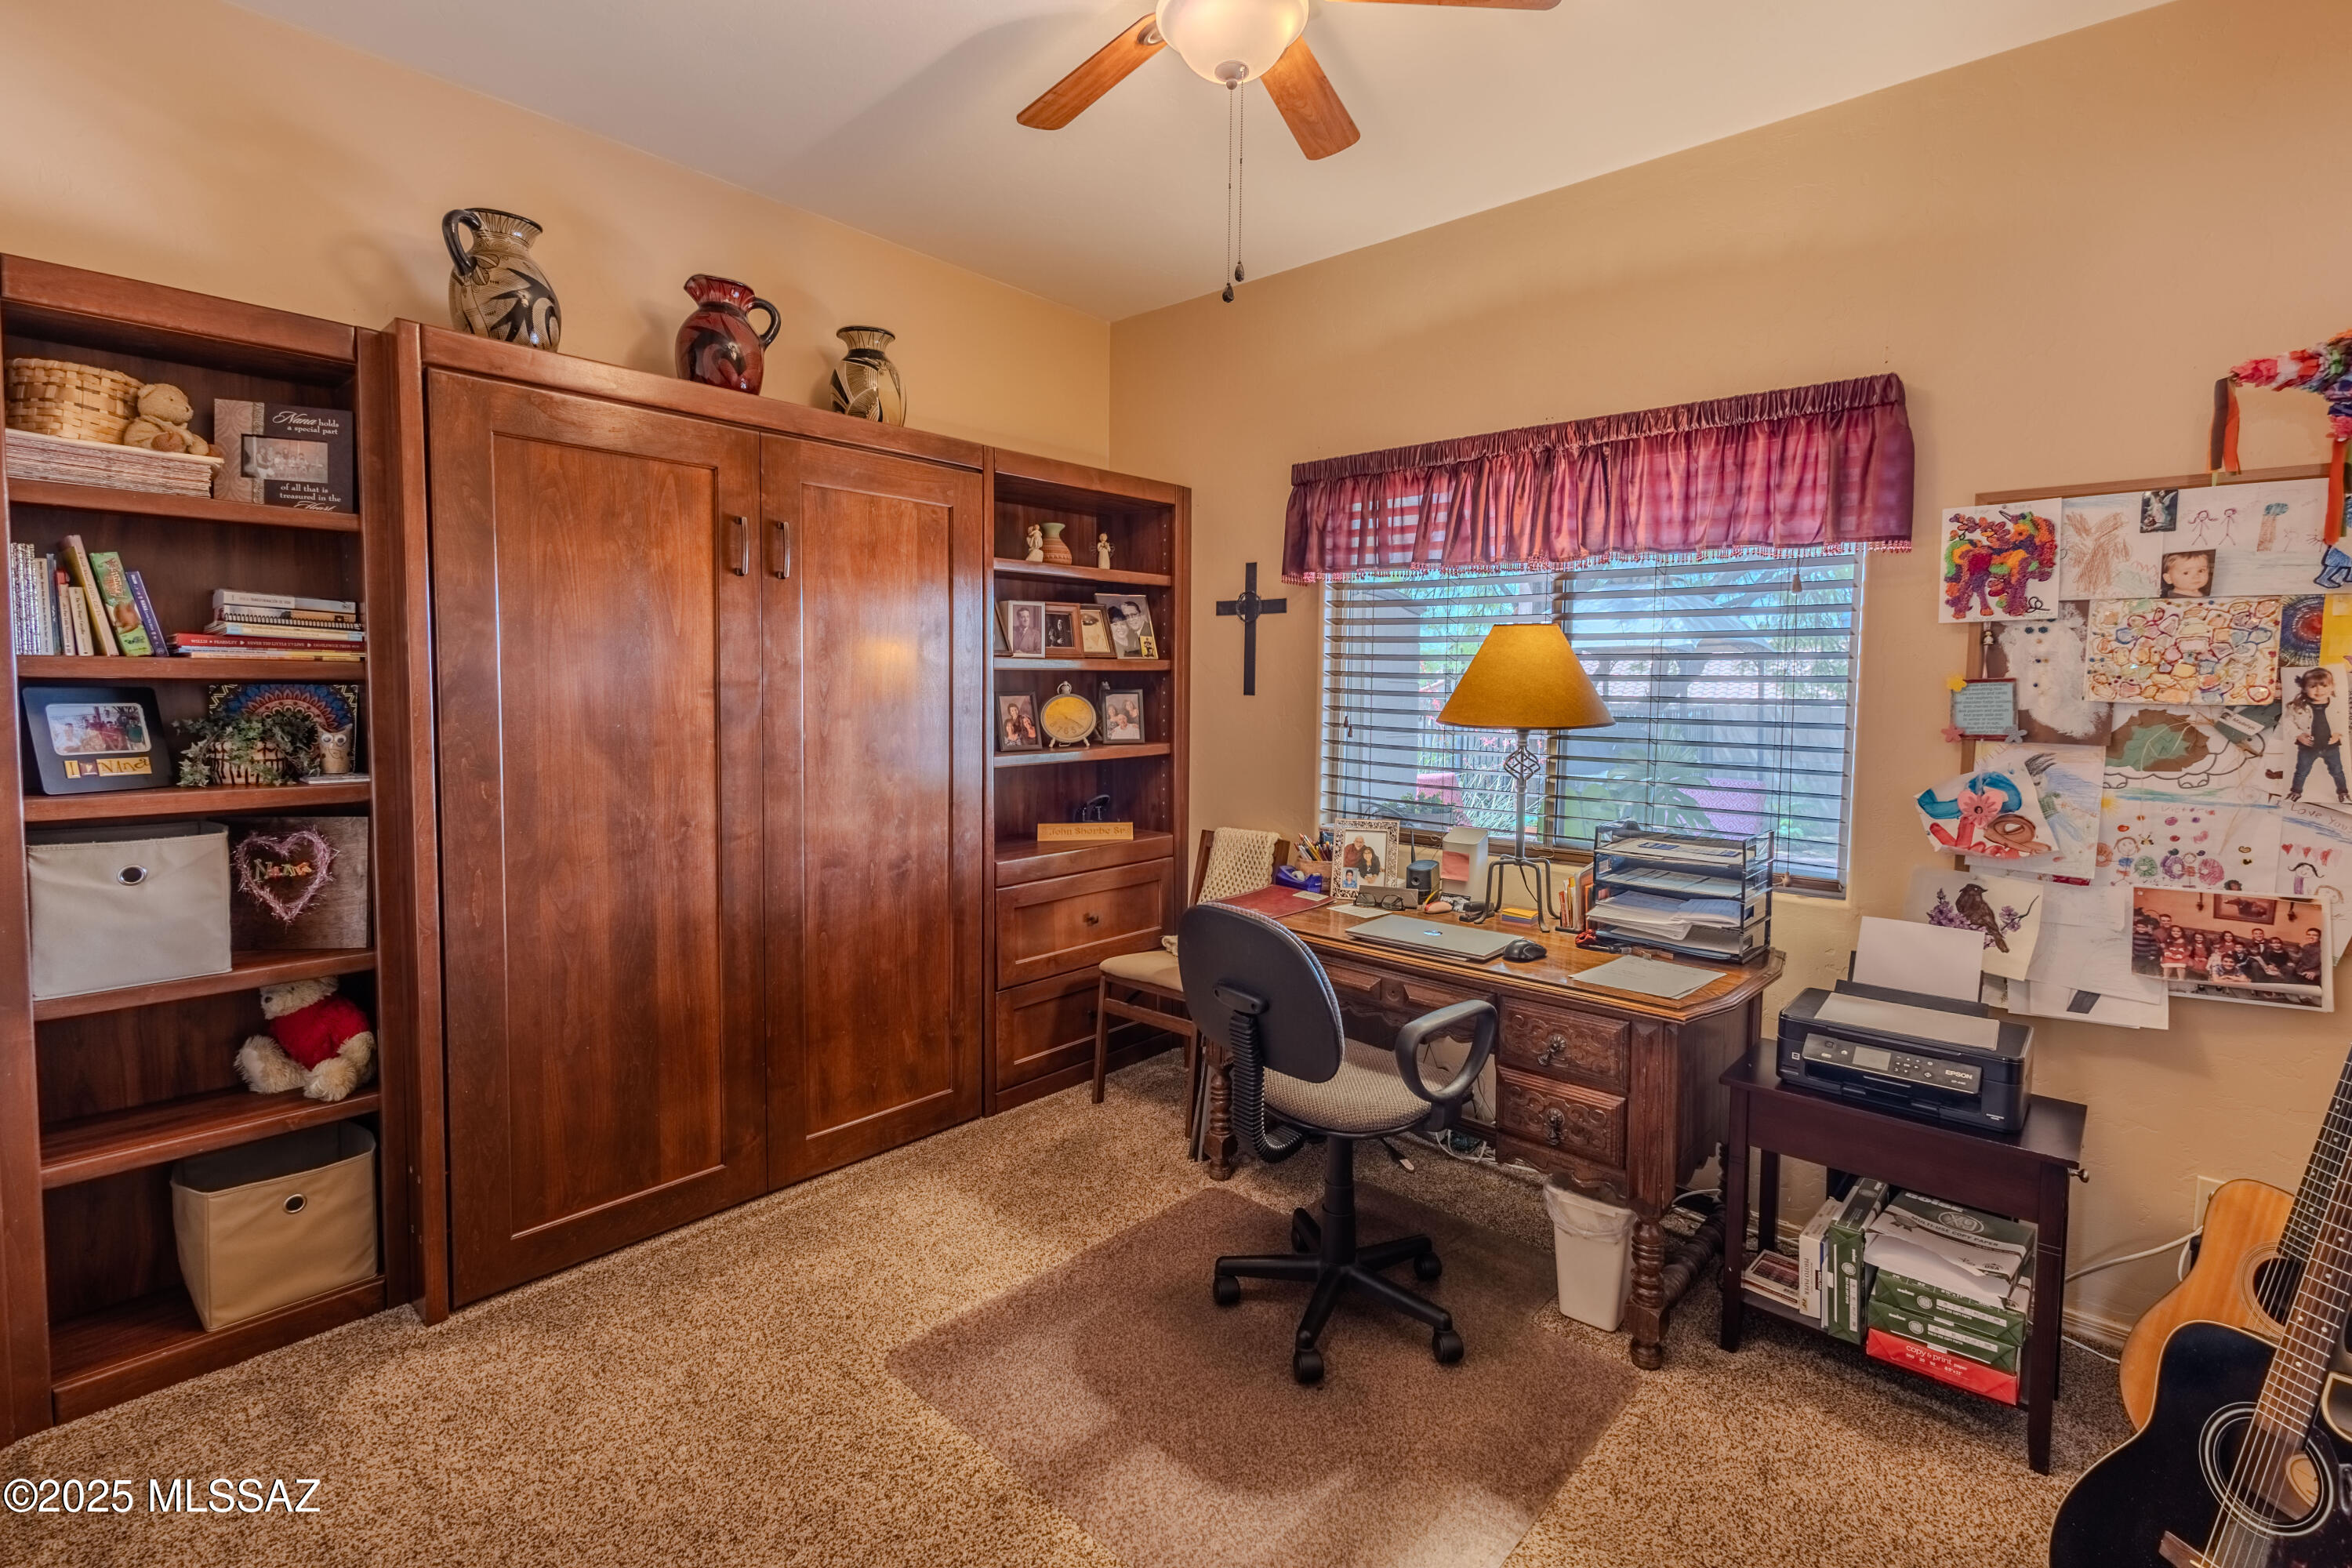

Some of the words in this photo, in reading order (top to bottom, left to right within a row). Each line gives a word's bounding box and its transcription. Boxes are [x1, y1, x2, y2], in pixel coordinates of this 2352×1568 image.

[272, 411, 318, 425] Nana
[318, 419, 339, 427] holds
[303, 485, 319, 493] that
[2290, 803, 2322, 817] Love
[1945, 1069, 1973, 1080] EPSON
[1911, 1216, 1949, 1234] MULTI-USE
[1951, 1230, 1971, 1240] COPY
[1974, 1236, 1998, 1247] PAPER
[1906, 1345, 1927, 1358] copy
[1933, 1354, 1952, 1366] print
